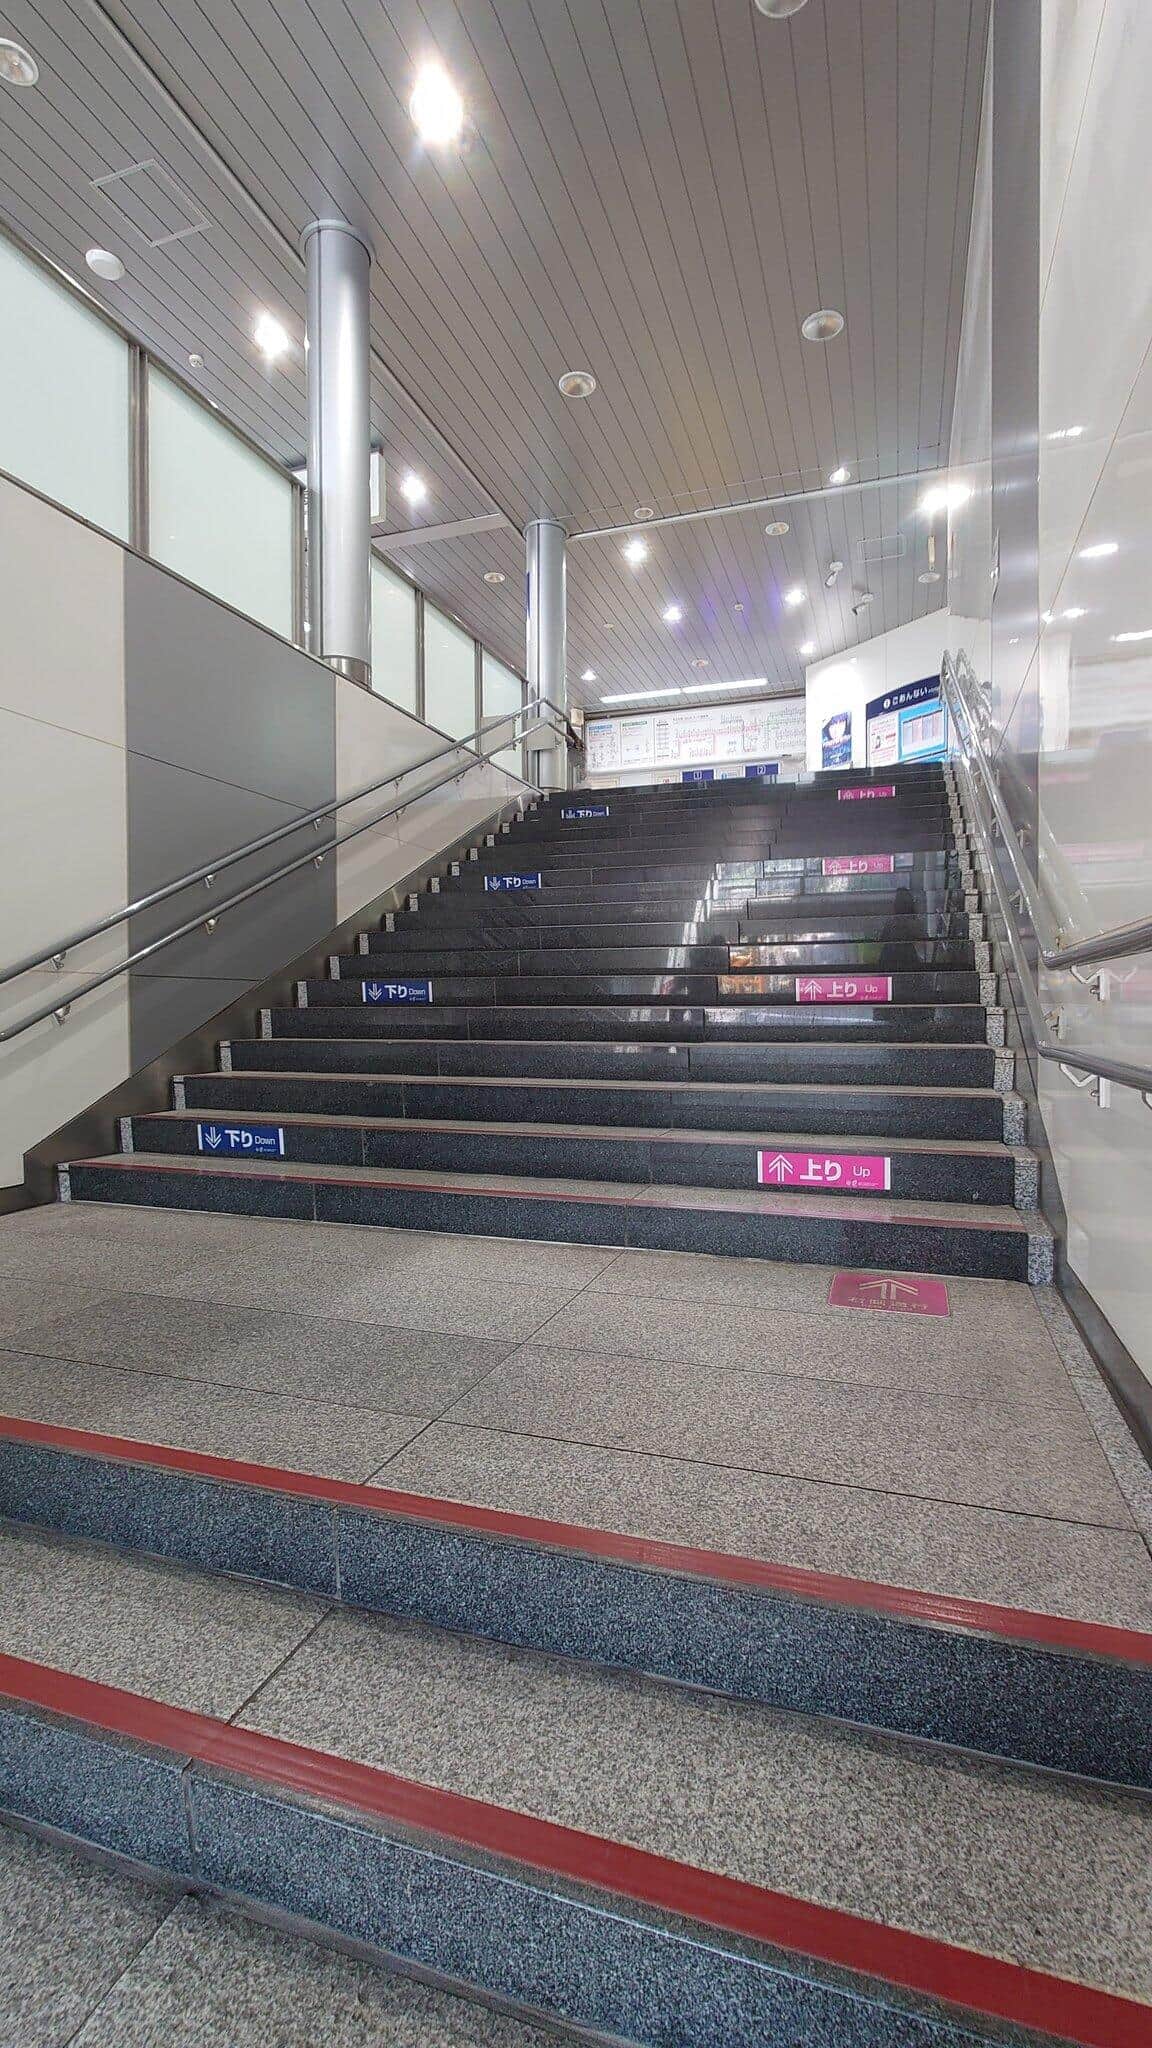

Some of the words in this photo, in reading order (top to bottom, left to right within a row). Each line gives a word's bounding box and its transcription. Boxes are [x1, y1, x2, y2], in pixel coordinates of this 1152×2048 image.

[845, 859, 868, 874] 上り
[502, 876, 521, 889] 下り
[384, 984, 408, 999] 下り
[408, 988, 426, 996] Down
[826, 981, 857, 998] 上り
[864, 984, 878, 993] Up
[224, 1129, 253, 1148] 下り
[254, 1136, 276, 1146] Down
[799, 1158, 842, 1182] 上り
[852, 1165, 871, 1179] Up
